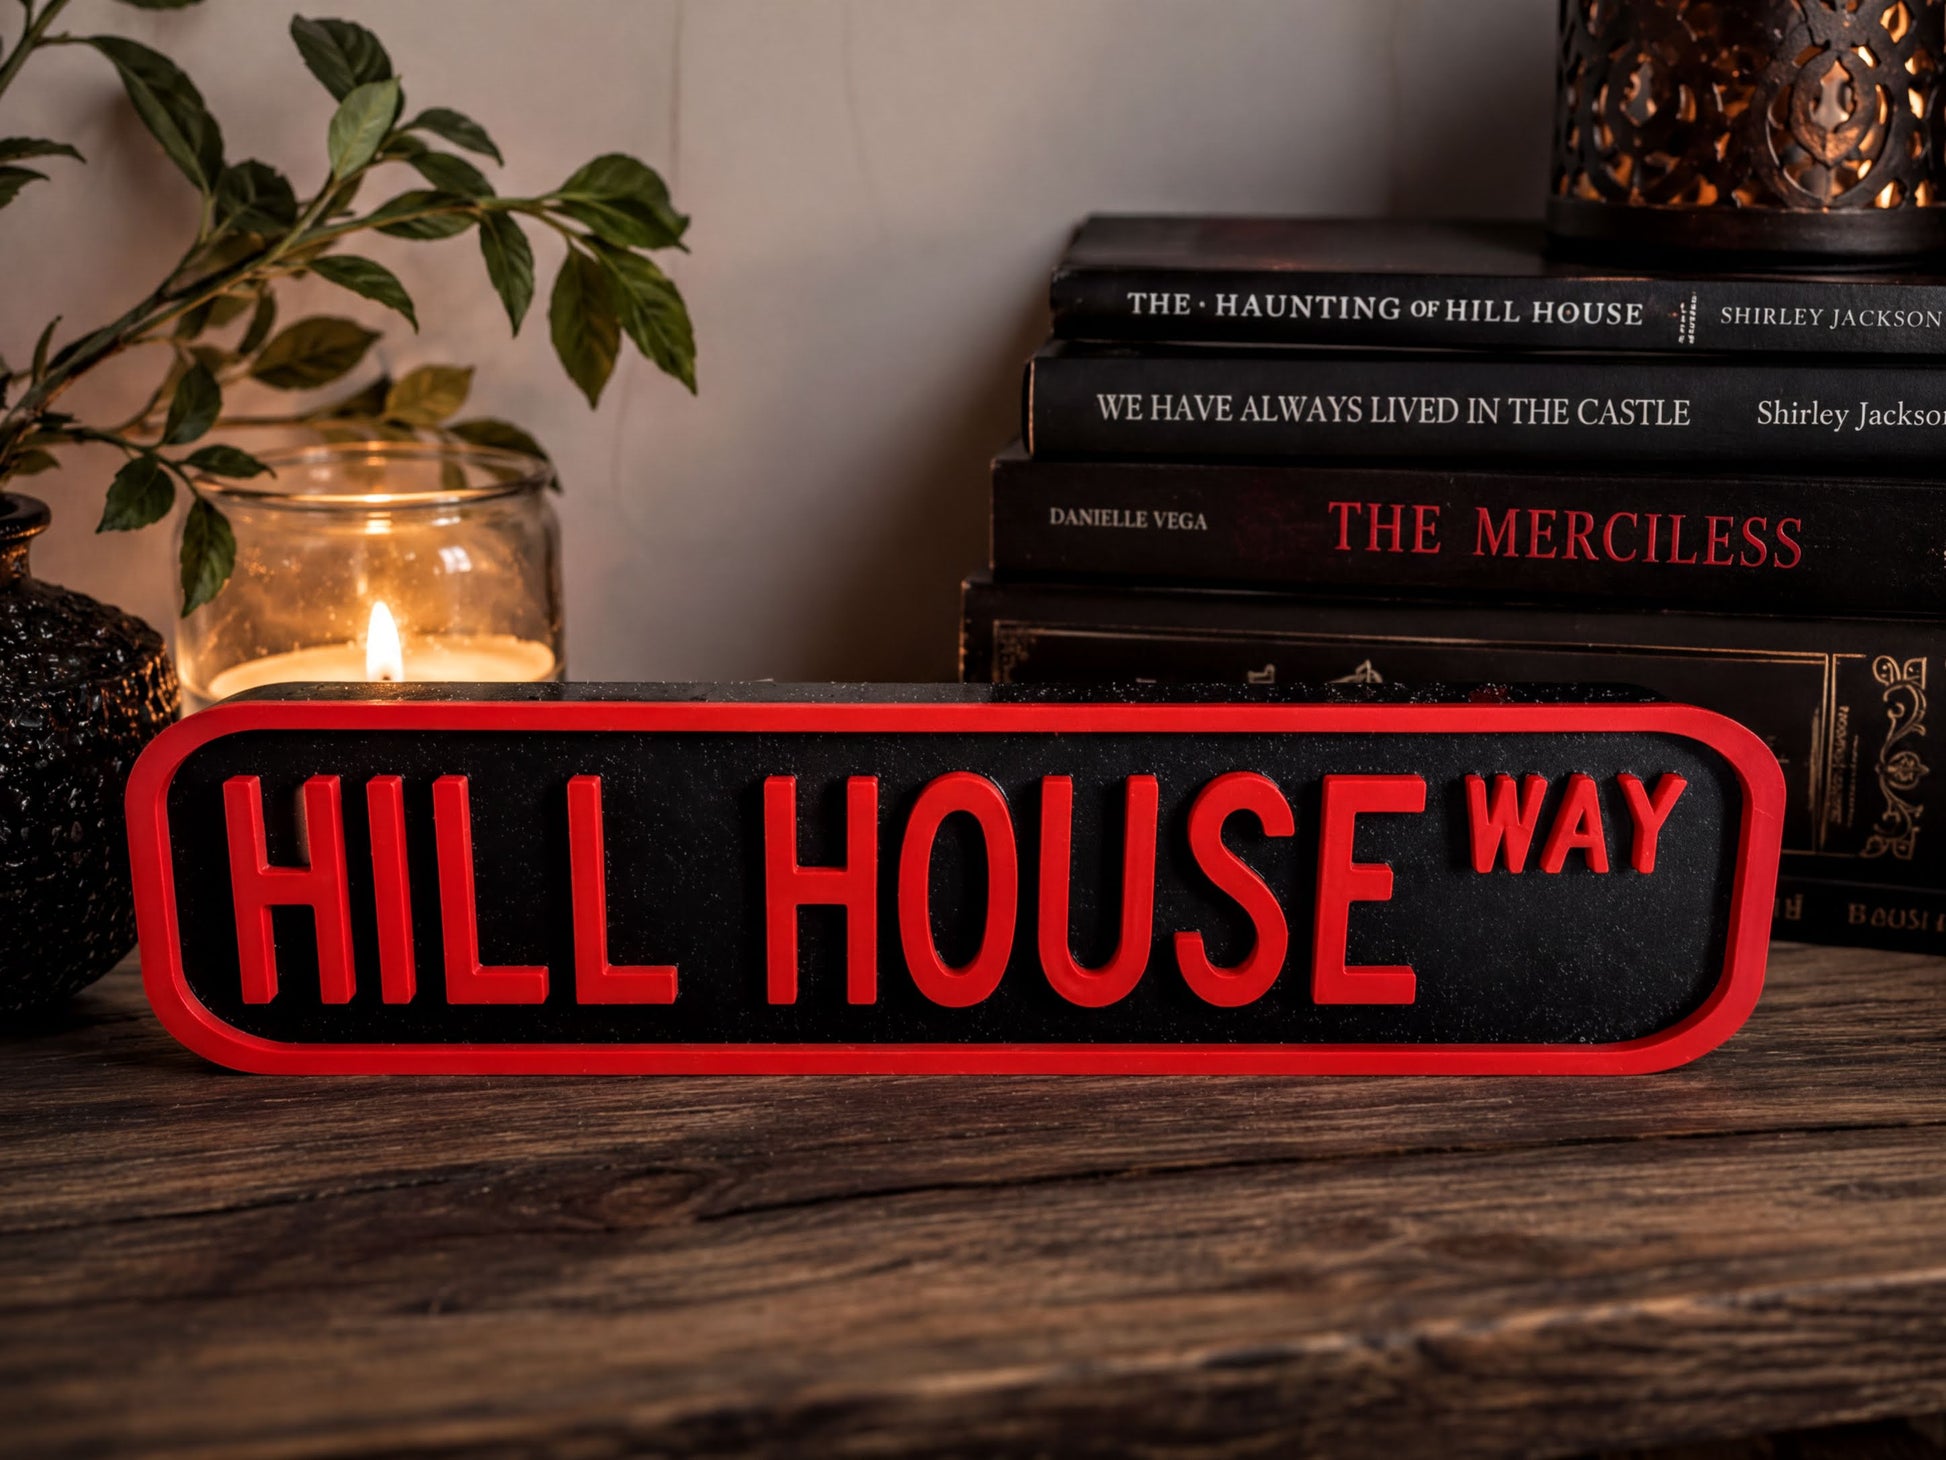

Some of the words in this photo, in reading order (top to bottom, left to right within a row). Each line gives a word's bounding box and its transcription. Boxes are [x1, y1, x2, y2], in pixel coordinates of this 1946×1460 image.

[1126, 292, 1191, 315] THE
[1215, 293, 1401, 320] HAUNTING
[1410, 300, 1441, 318] OF
[1446, 299, 1521, 323] HILL
[1532, 301, 1644, 326] HOUSE
[1720, 306, 1824, 326] SHIRLEY
[1829, 308, 1943, 330] JACKSON
[1096, 393, 1143, 421] WE
[1150, 394, 1233, 422] HAVE
[1239, 395, 1363, 423] ALWAYS
[1370, 396, 1459, 424] LIVED
[1466, 397, 1504, 424] IN
[1508, 397, 1570, 425] THE
[1577, 398, 1691, 426] CASTLE
[1757, 400, 1850, 433] Shirley
[1050, 507, 1148, 529] DANIELLE
[1153, 510, 1208, 531] VEGA
[1328, 501, 1441, 554] THE
[1473, 506, 1803, 569] MERCILESS
[1464, 773, 1688, 874] WAY
[222, 774, 679, 1005] HILL
[763, 771, 1427, 1008] HOUSE
